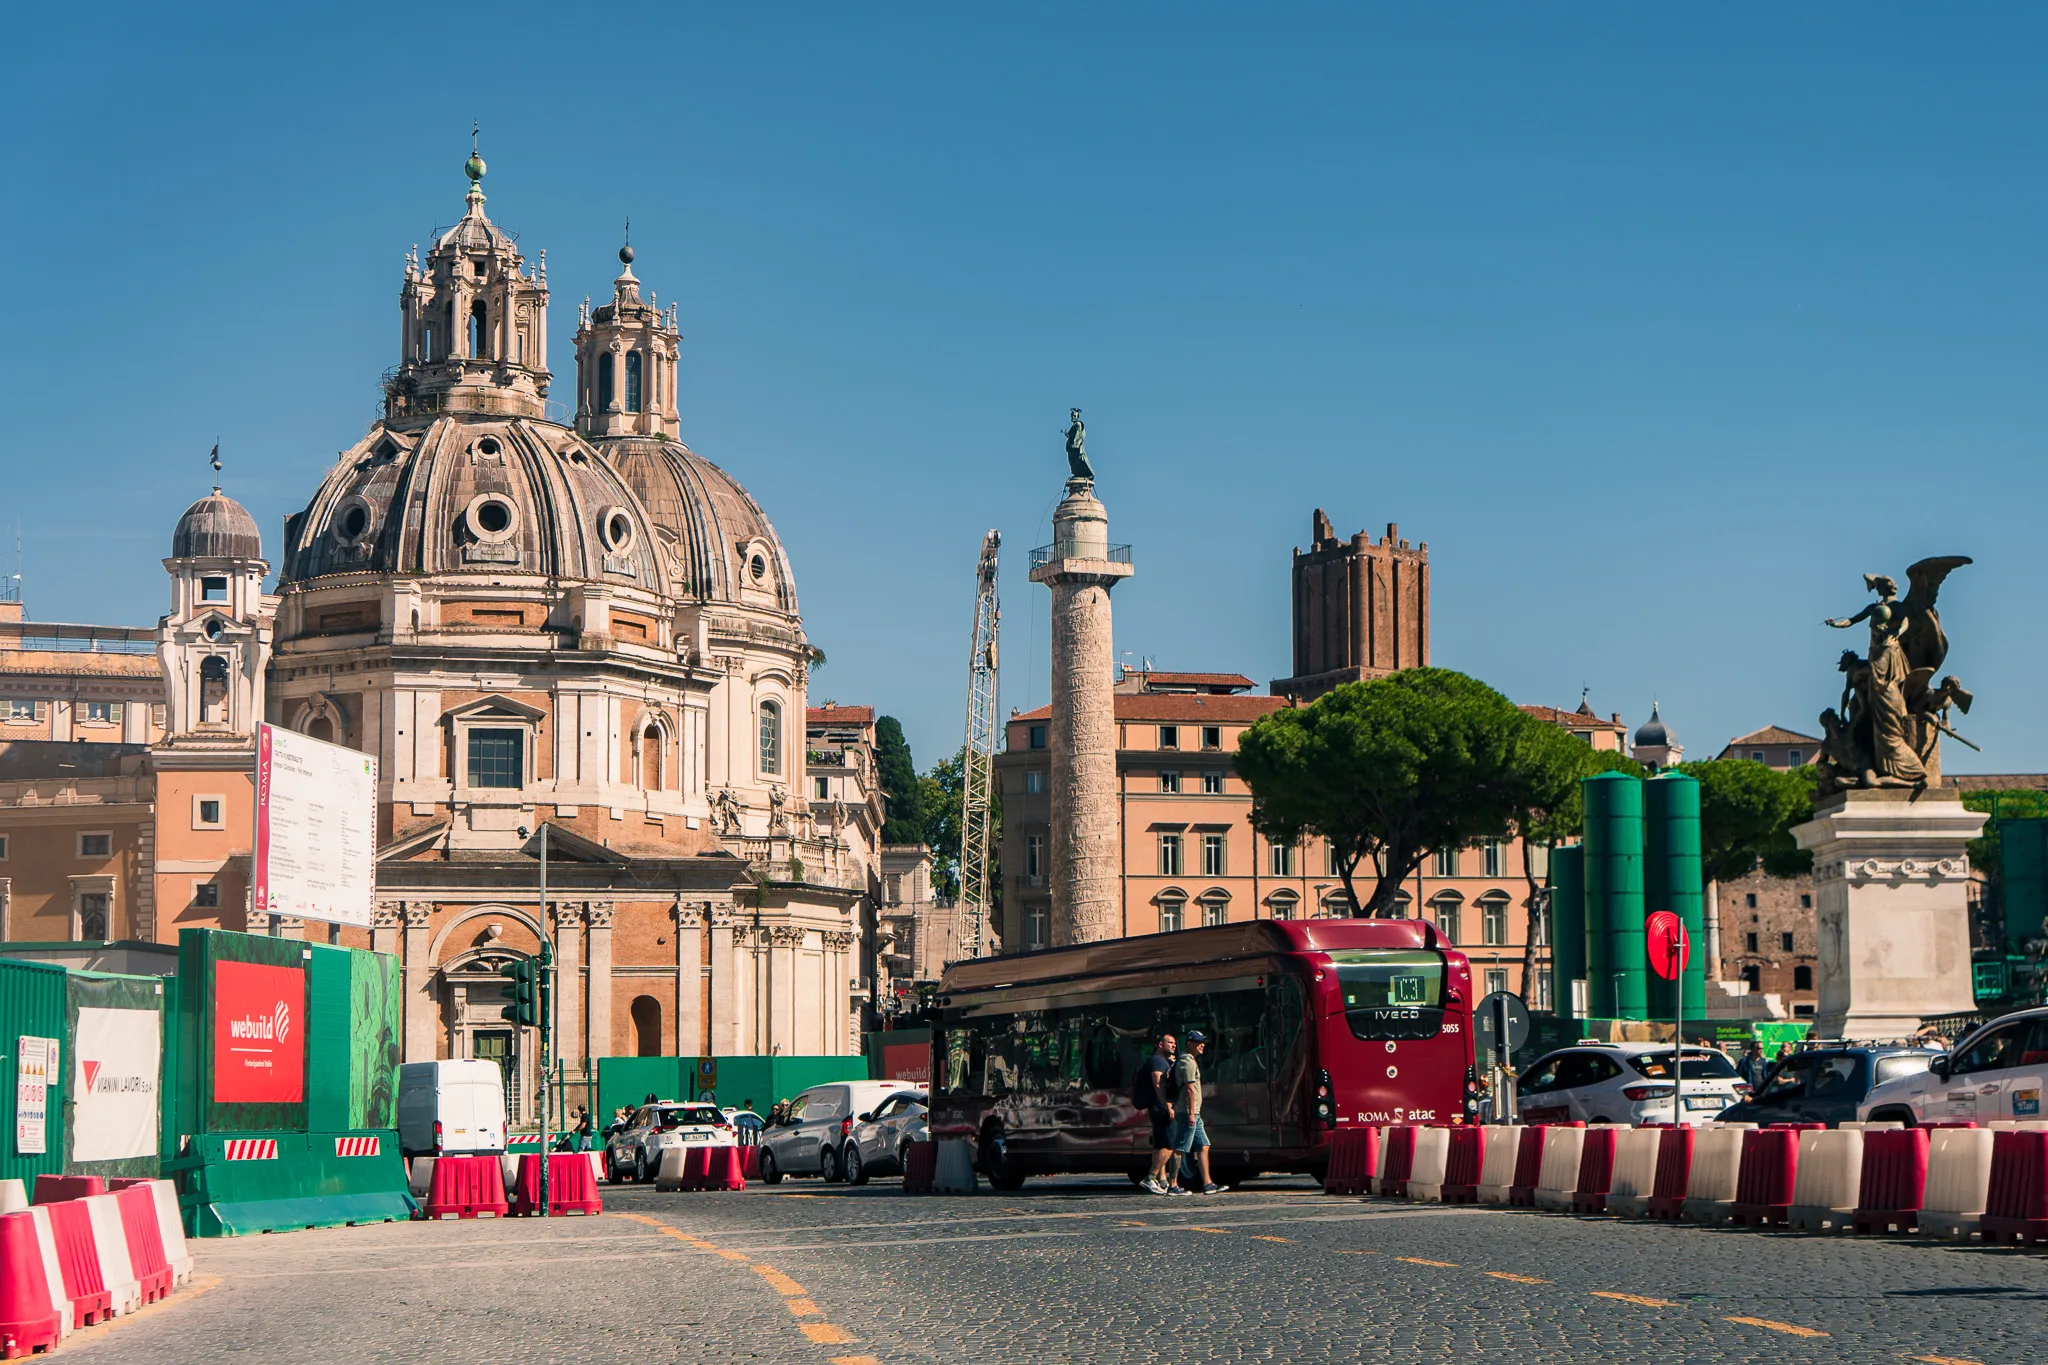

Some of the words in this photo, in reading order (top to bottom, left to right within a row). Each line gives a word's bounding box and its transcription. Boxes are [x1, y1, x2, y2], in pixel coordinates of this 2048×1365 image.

[260, 761, 268, 806] ROMA
[1375, 1011, 1419, 1019] IVECO
[231, 1014, 273, 1039] webuild
[1442, 1024, 1459, 1033] 5055
[896, 1067, 926, 1080] webuild
[97, 1077, 119, 1092] VIANINI
[121, 1077, 141, 1092] LAVORI
[1358, 1112, 1390, 1122] ROMA
[1408, 1109, 1436, 1120] atac
